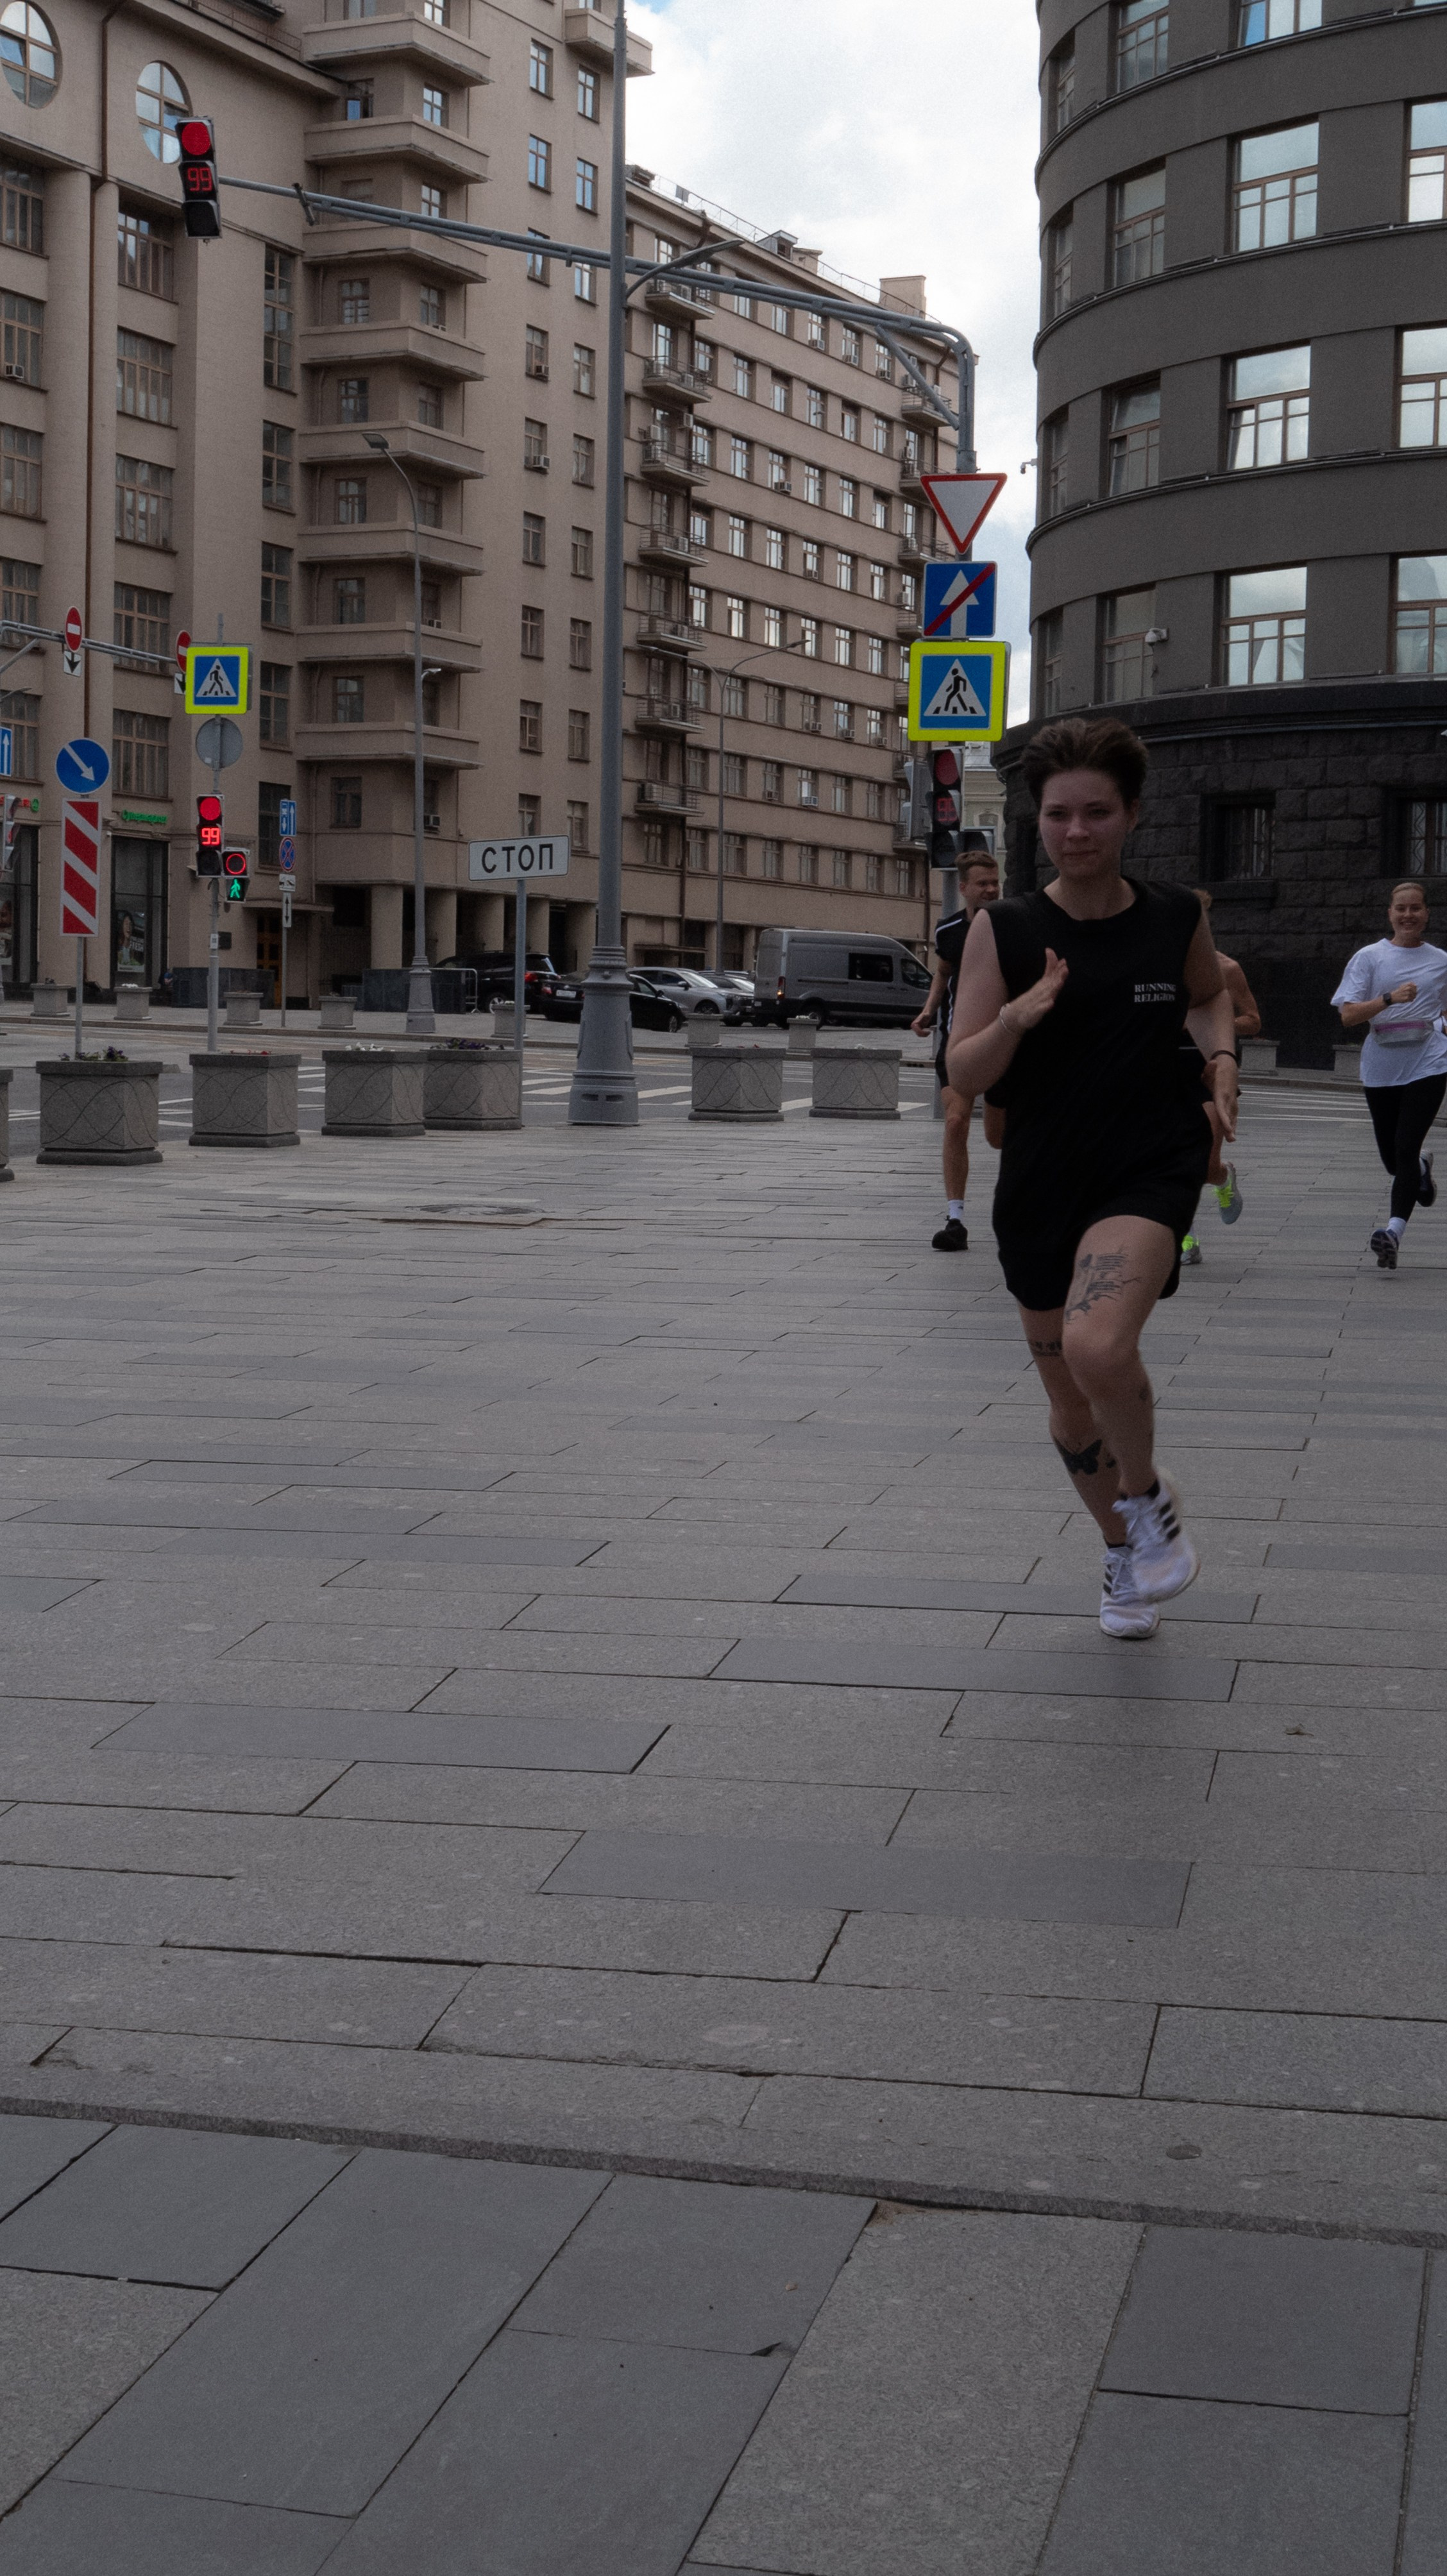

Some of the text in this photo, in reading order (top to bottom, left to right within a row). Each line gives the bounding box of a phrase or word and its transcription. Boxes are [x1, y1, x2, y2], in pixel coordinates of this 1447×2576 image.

[187, 167, 212, 191] 99
[201, 827, 221, 845] 99
[482, 843, 553, 873] СТОП
[1134, 983, 1176, 992] RUNNING
[1134, 993, 1175, 1002] RELIGION
